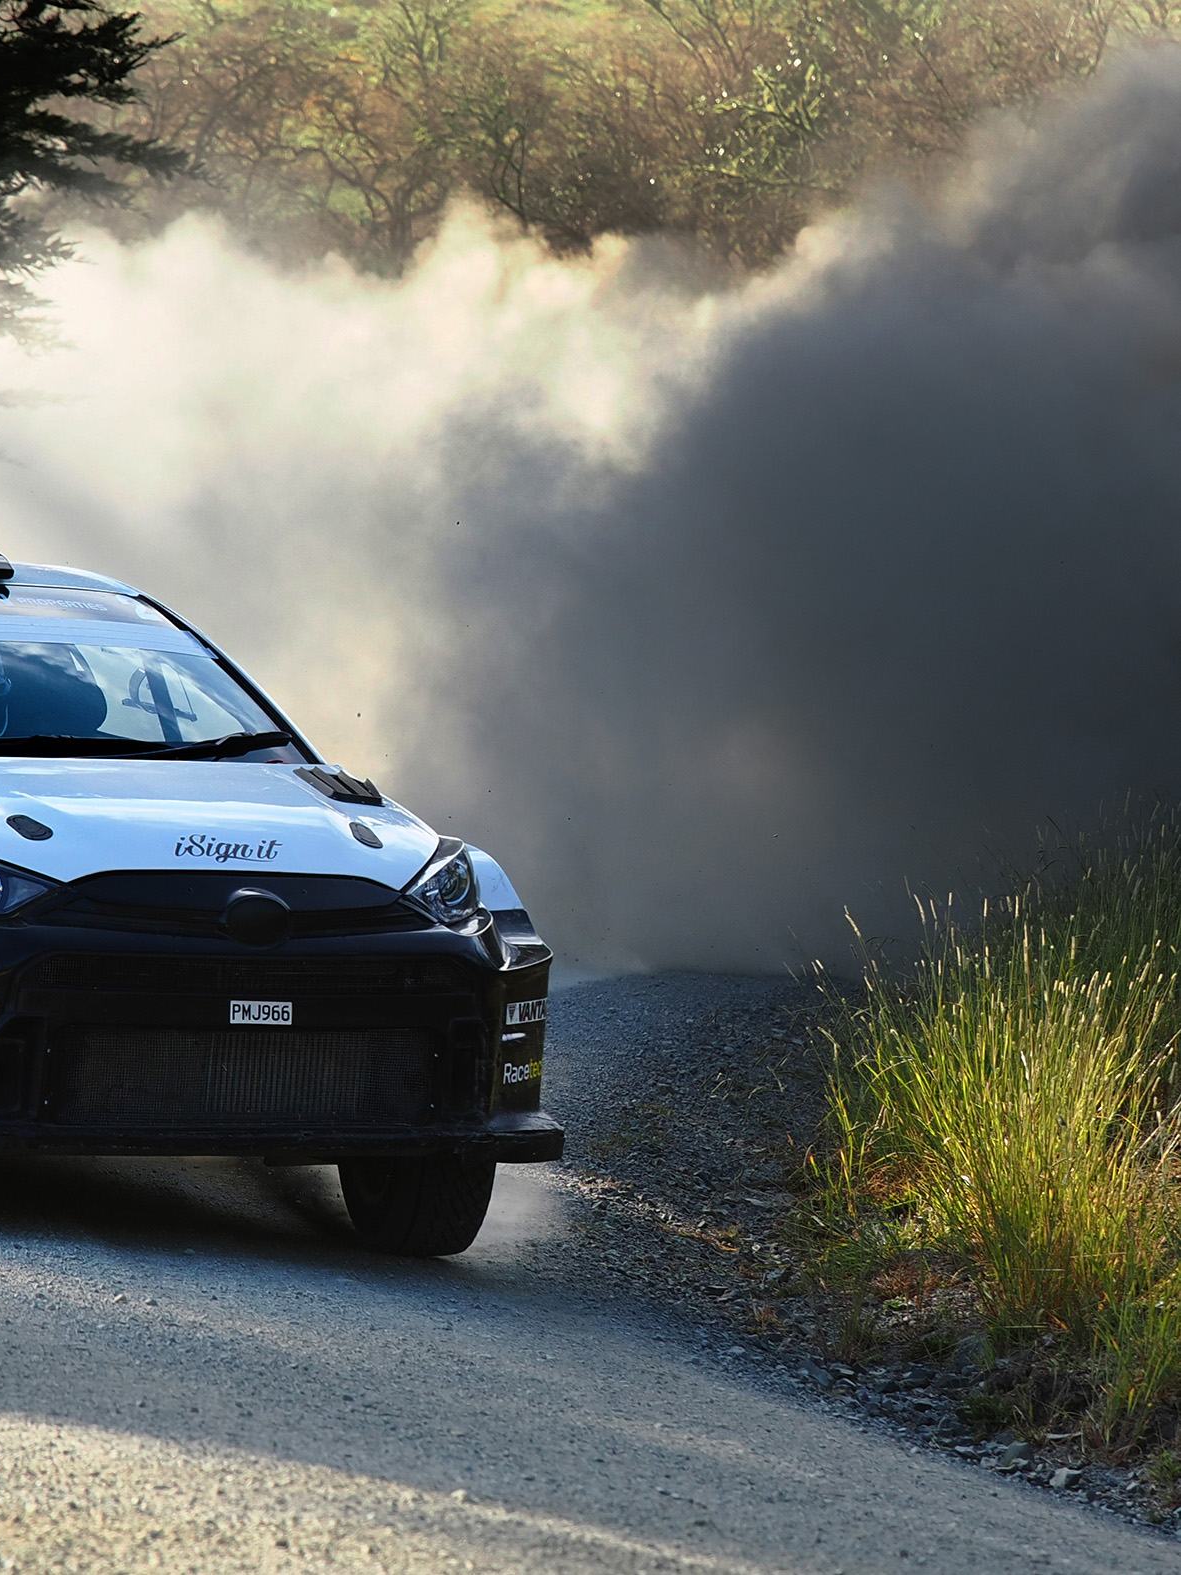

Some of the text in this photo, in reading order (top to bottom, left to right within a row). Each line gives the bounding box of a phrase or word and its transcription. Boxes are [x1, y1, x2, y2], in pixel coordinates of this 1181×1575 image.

[16, 597, 108, 611] PROPERTIES
[175, 834, 283, 863] iSign it
[232, 1004, 290, 1021] PMJ966
